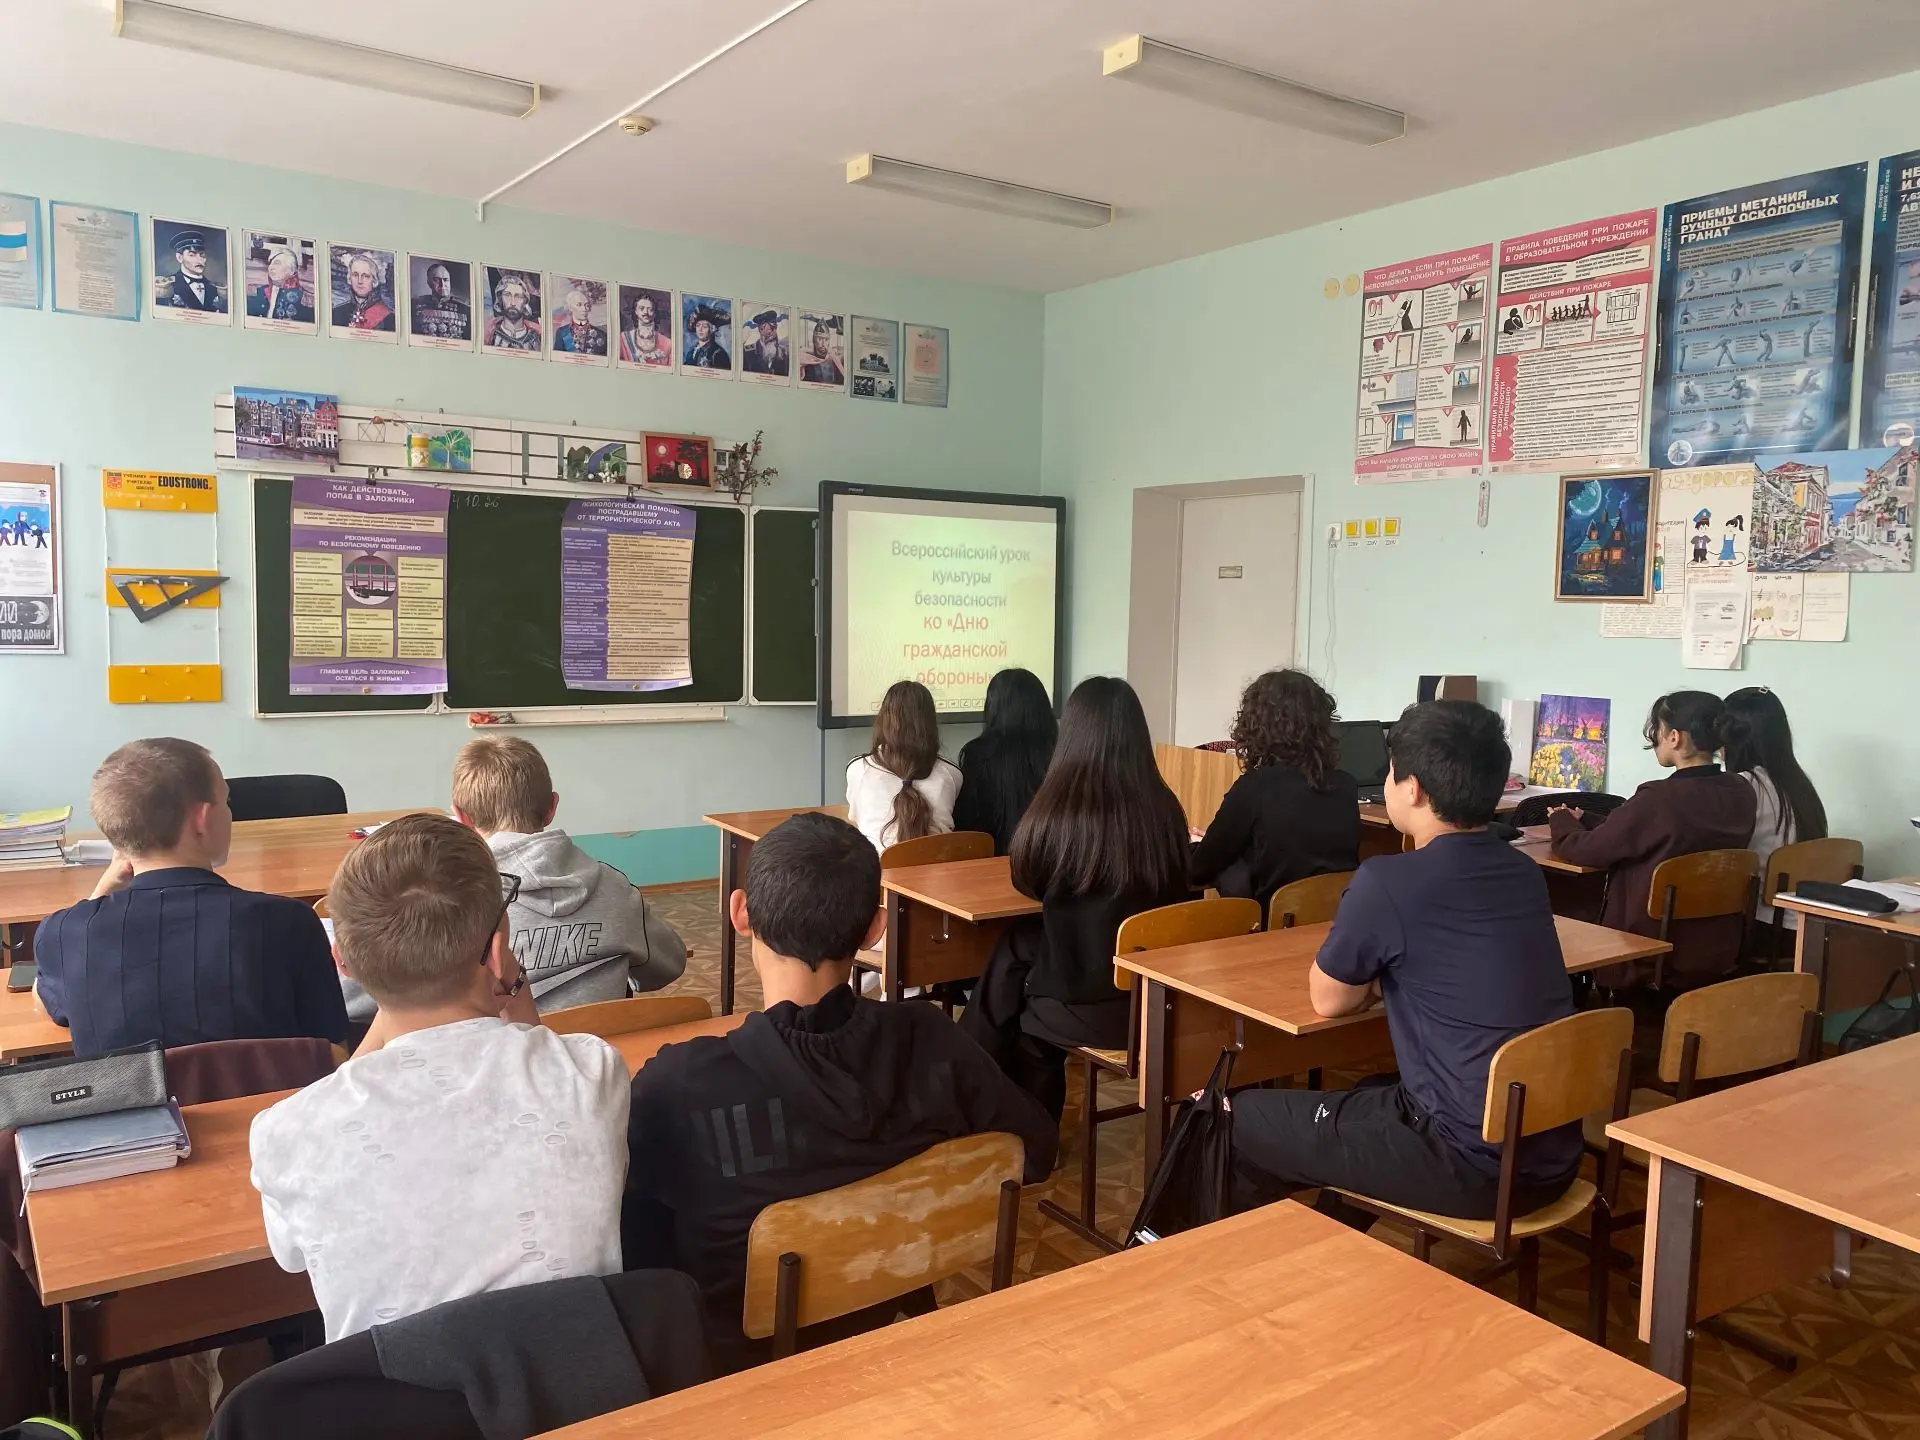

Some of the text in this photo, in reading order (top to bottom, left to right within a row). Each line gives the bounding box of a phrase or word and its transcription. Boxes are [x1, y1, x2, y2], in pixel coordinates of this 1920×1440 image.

[1680, 194, 1840, 235] РУЧНЫХ ОСКОЛОЧНЫХ
[1681, 190, 1807, 224] ПРИЕМЫ МЕТАНИЯ
[1506, 218, 1649, 253] ПРАВИЛА ПОВЕДЕНИЯ ПРИ ПОЖАРЕ
[1513, 240, 1588, 260] ОБРАЗОВАТЕЛЬНОМ
[1591, 228, 1649, 245] УЧРЕЖДЕНИИ
[1680, 226, 1730, 244] ГРАНАТ
[1365, 259, 1491, 290] НЕВОЗМОЖНО ПОКИНУТЬ ПОМЕЩЕНИЕ
[1374, 273, 1387, 281] ЧТО
[1415, 263, 1433, 271] ЕСЛИ
[1435, 259, 1451, 267] ПРИ
[1452, 253, 1481, 264] ПОЖАРЕ
[1528, 281, 1612, 301] ДЕЙСТВИЯ ПРИ ПОЖАРЕ
[1368, 298, 1384, 317] 01
[1523, 304, 1542, 324] 01
[1493, 366, 1501, 406] ПОЖАРНОЙ
[1497, 381, 1506, 437] БЕЗОПАСНОСТИ
[1503, 386, 1512, 431] ЗАПРЕЩЕНО
[158, 475, 209, 490] EDUSTRONG
[350, 485, 409, 496] ДЕЙСТВОВАТЬ,
[326, 492, 353, 500] ПОПАВ
[365, 494, 415, 504] ЗАЛОЖНИКИ
[581, 501, 680, 515] ПСИХОЛОГИЧЕСКАЯ ПОМОЩЬ
[589, 515, 661, 525] ТЕРРОРИСТИЧЕСКОГО
[598, 509, 659, 518] ПОСТРАДАВШЕМУ
[331, 541, 379, 549] БЕЗОПАСНОМУ
[381, 543, 421, 551] ПОВЕДЕНИЮ
[344, 534, 397, 543] РЕКОМЕНДАЦИИ
[891, 540, 1031, 564] Всероссийский урок
[932, 570, 992, 586] культуры
[915, 589, 1007, 607] безопасности
[924, 612, 989, 632] ко «Дню
[1, 625, 51, 643] пора домой
[903, 640, 1007, 660] гражданской
[512, 923, 602, 970] NIKE
[55, 1088, 86, 1101] STYLE
